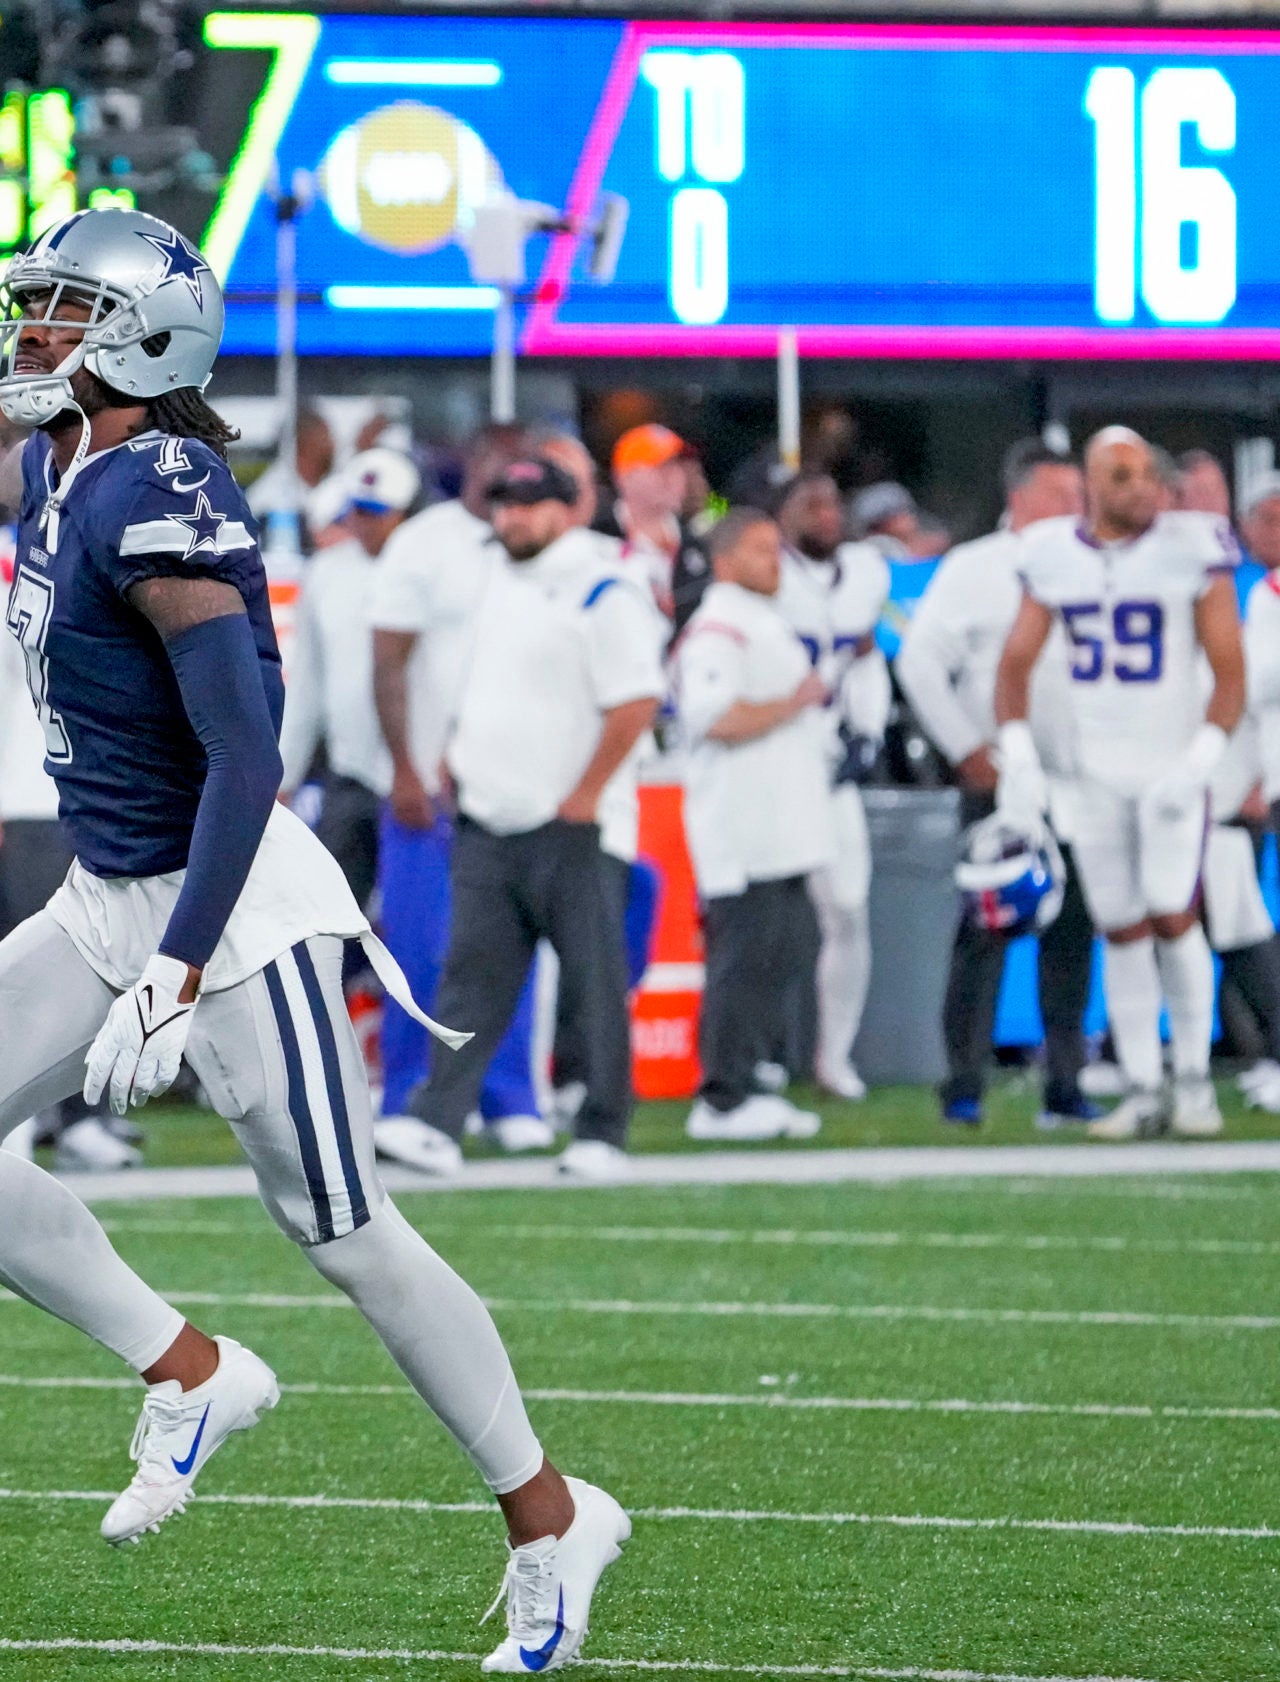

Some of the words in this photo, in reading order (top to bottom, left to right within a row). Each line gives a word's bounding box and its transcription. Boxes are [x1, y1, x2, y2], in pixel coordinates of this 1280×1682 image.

[1082, 66, 1238, 324] 16
[6, 564, 72, 764] 7
[1060, 601, 1163, 683] 59
